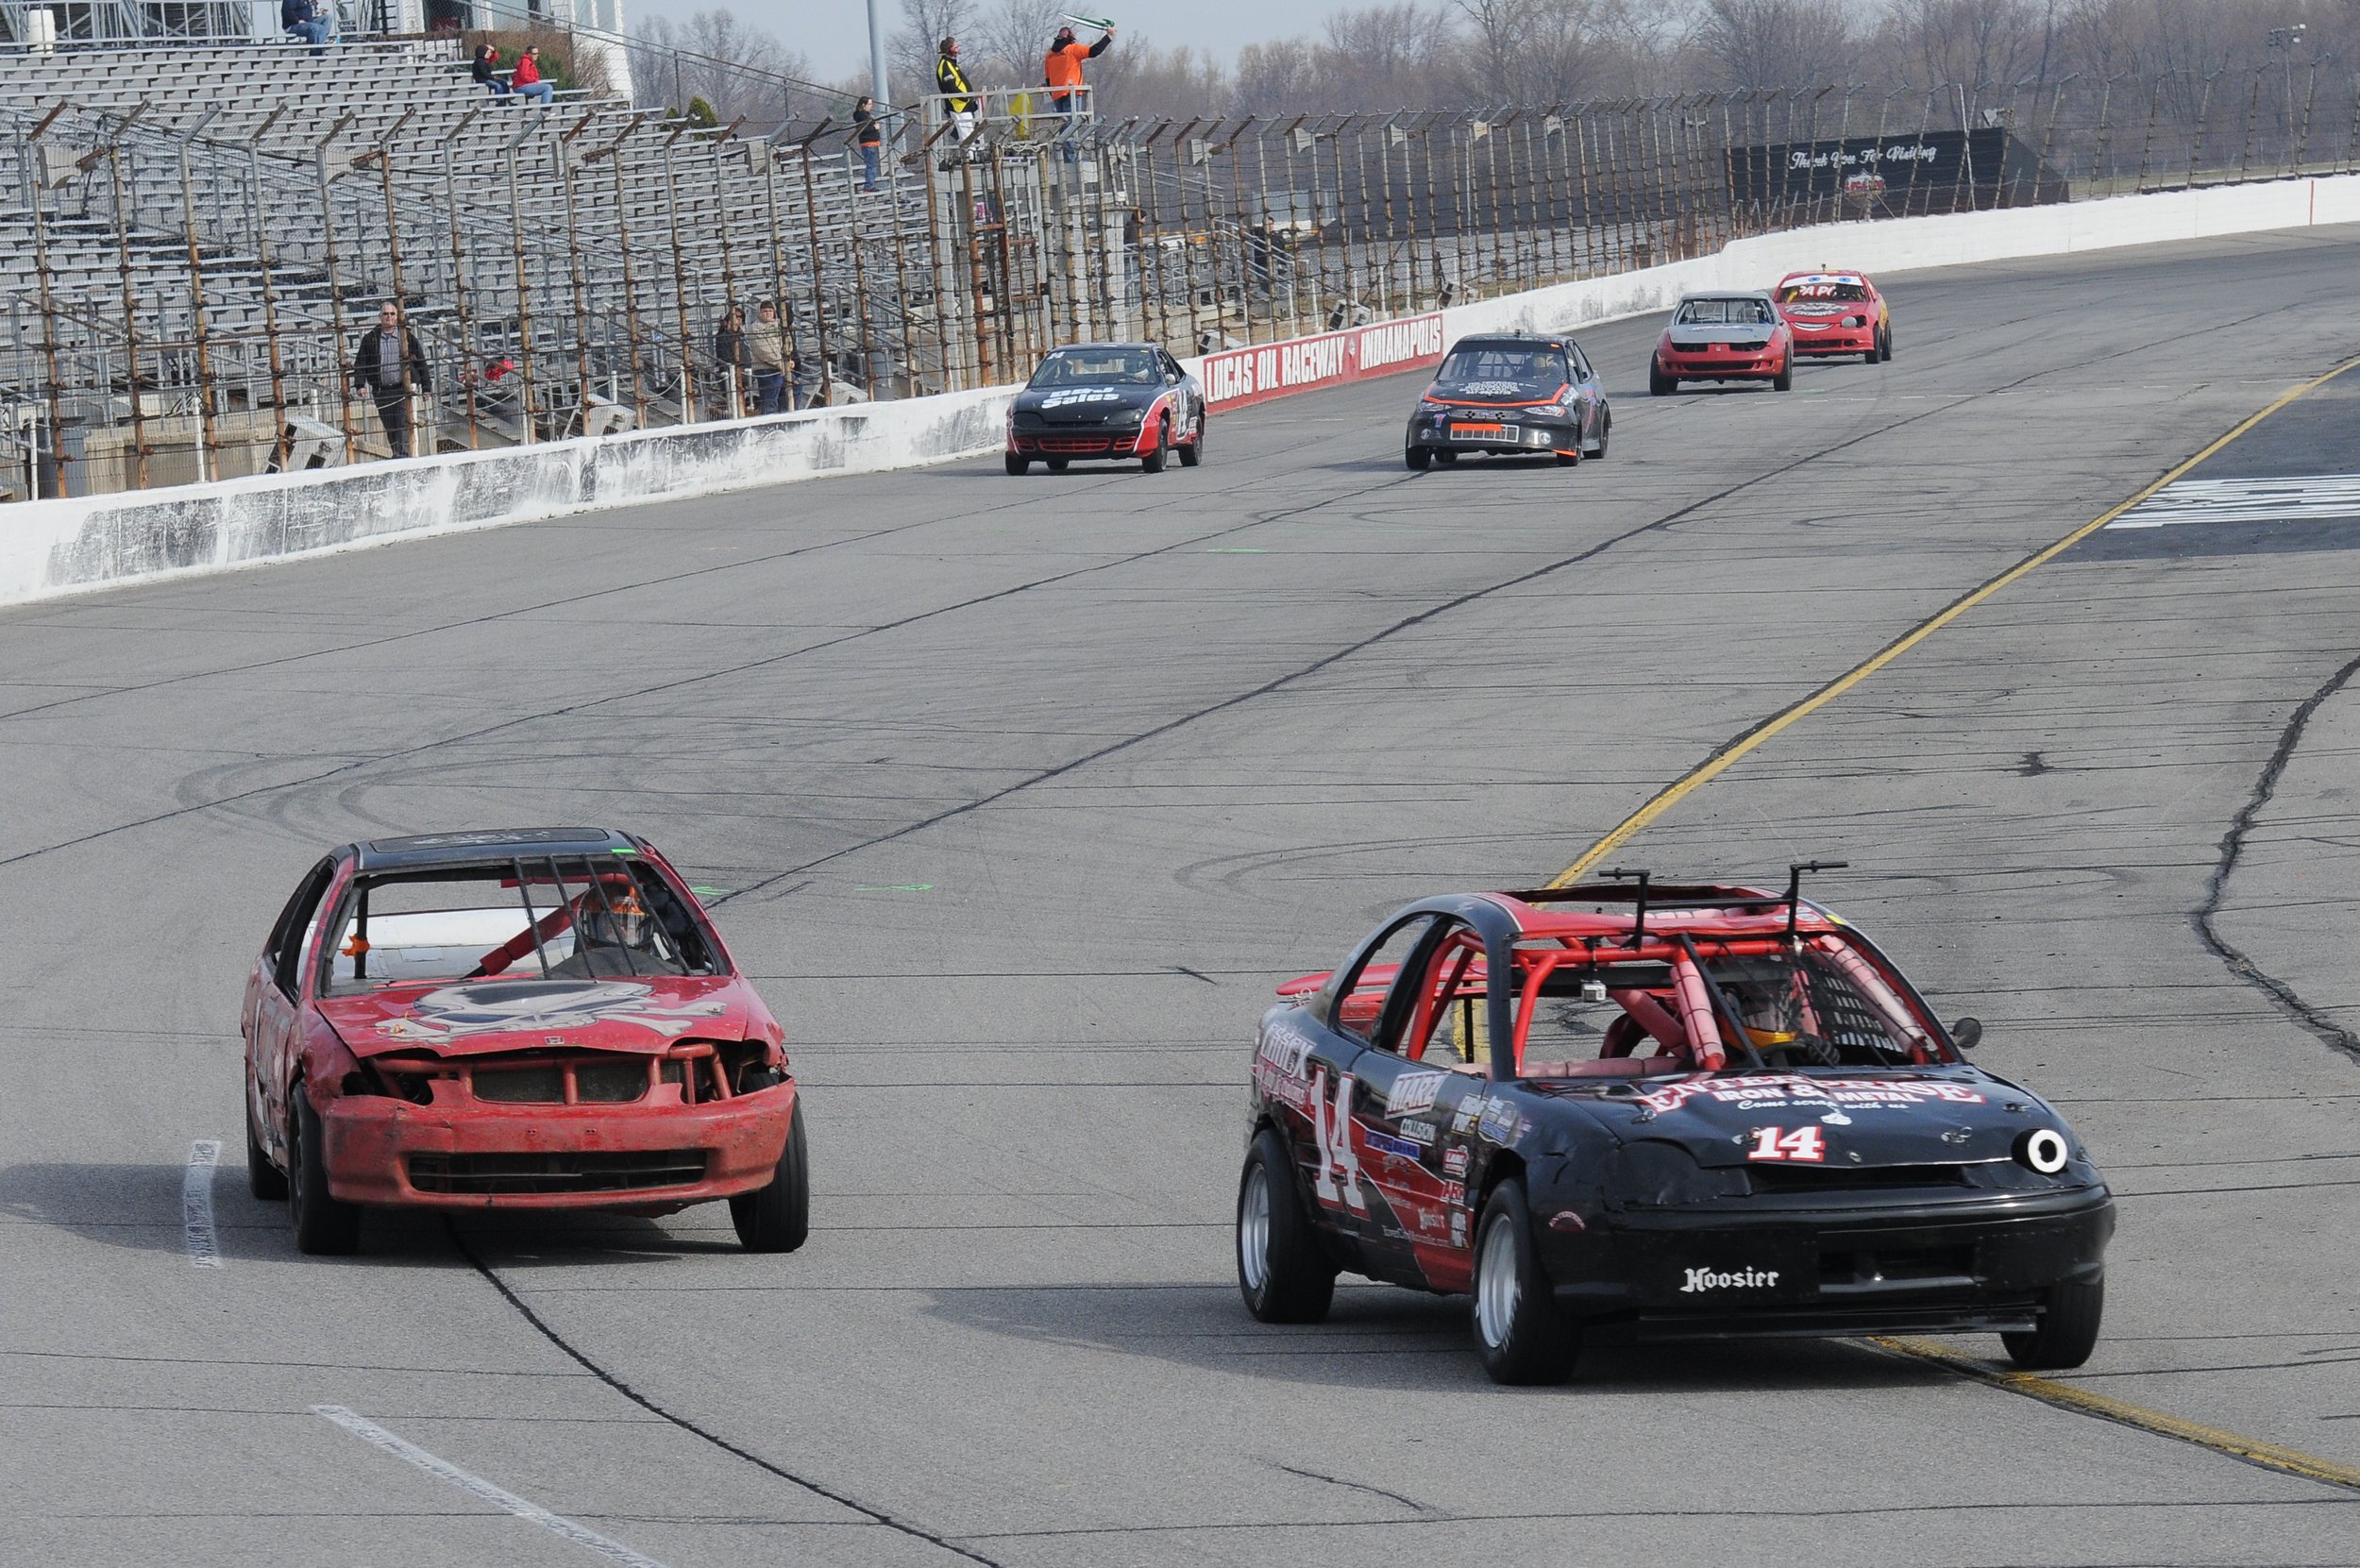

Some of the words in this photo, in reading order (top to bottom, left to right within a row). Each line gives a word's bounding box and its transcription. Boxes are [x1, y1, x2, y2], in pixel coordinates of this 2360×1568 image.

[1789, 151, 1829, 170] Thank
[1829, 151, 1857, 169] You
[1859, 148, 1884, 164] For
[1885, 144, 1938, 163] Visiting
[1206, 353, 1254, 403] LUCAS
[1256, 348, 1278, 392] OIL
[1281, 336, 1345, 387] RACEWAY
[1360, 317, 1441, 371] INDIANAPOLIS
[1041, 393, 1120, 410] Sales
[1638, 1075, 1986, 1113] ENTERPRISE
[1711, 1087, 1786, 1102] IRON
[1791, 1084, 1831, 1099] &
[1833, 1091, 1925, 1103] METAL
[1737, 1100, 1788, 1110] Come
[1844, 1101, 1882, 1110] with
[1308, 1065, 1370, 1221] 14
[1399, 1117, 1437, 1146] COLLISION
[1748, 1126, 1826, 1162] 14
[1679, 1265, 1779, 1292] Hoosier
